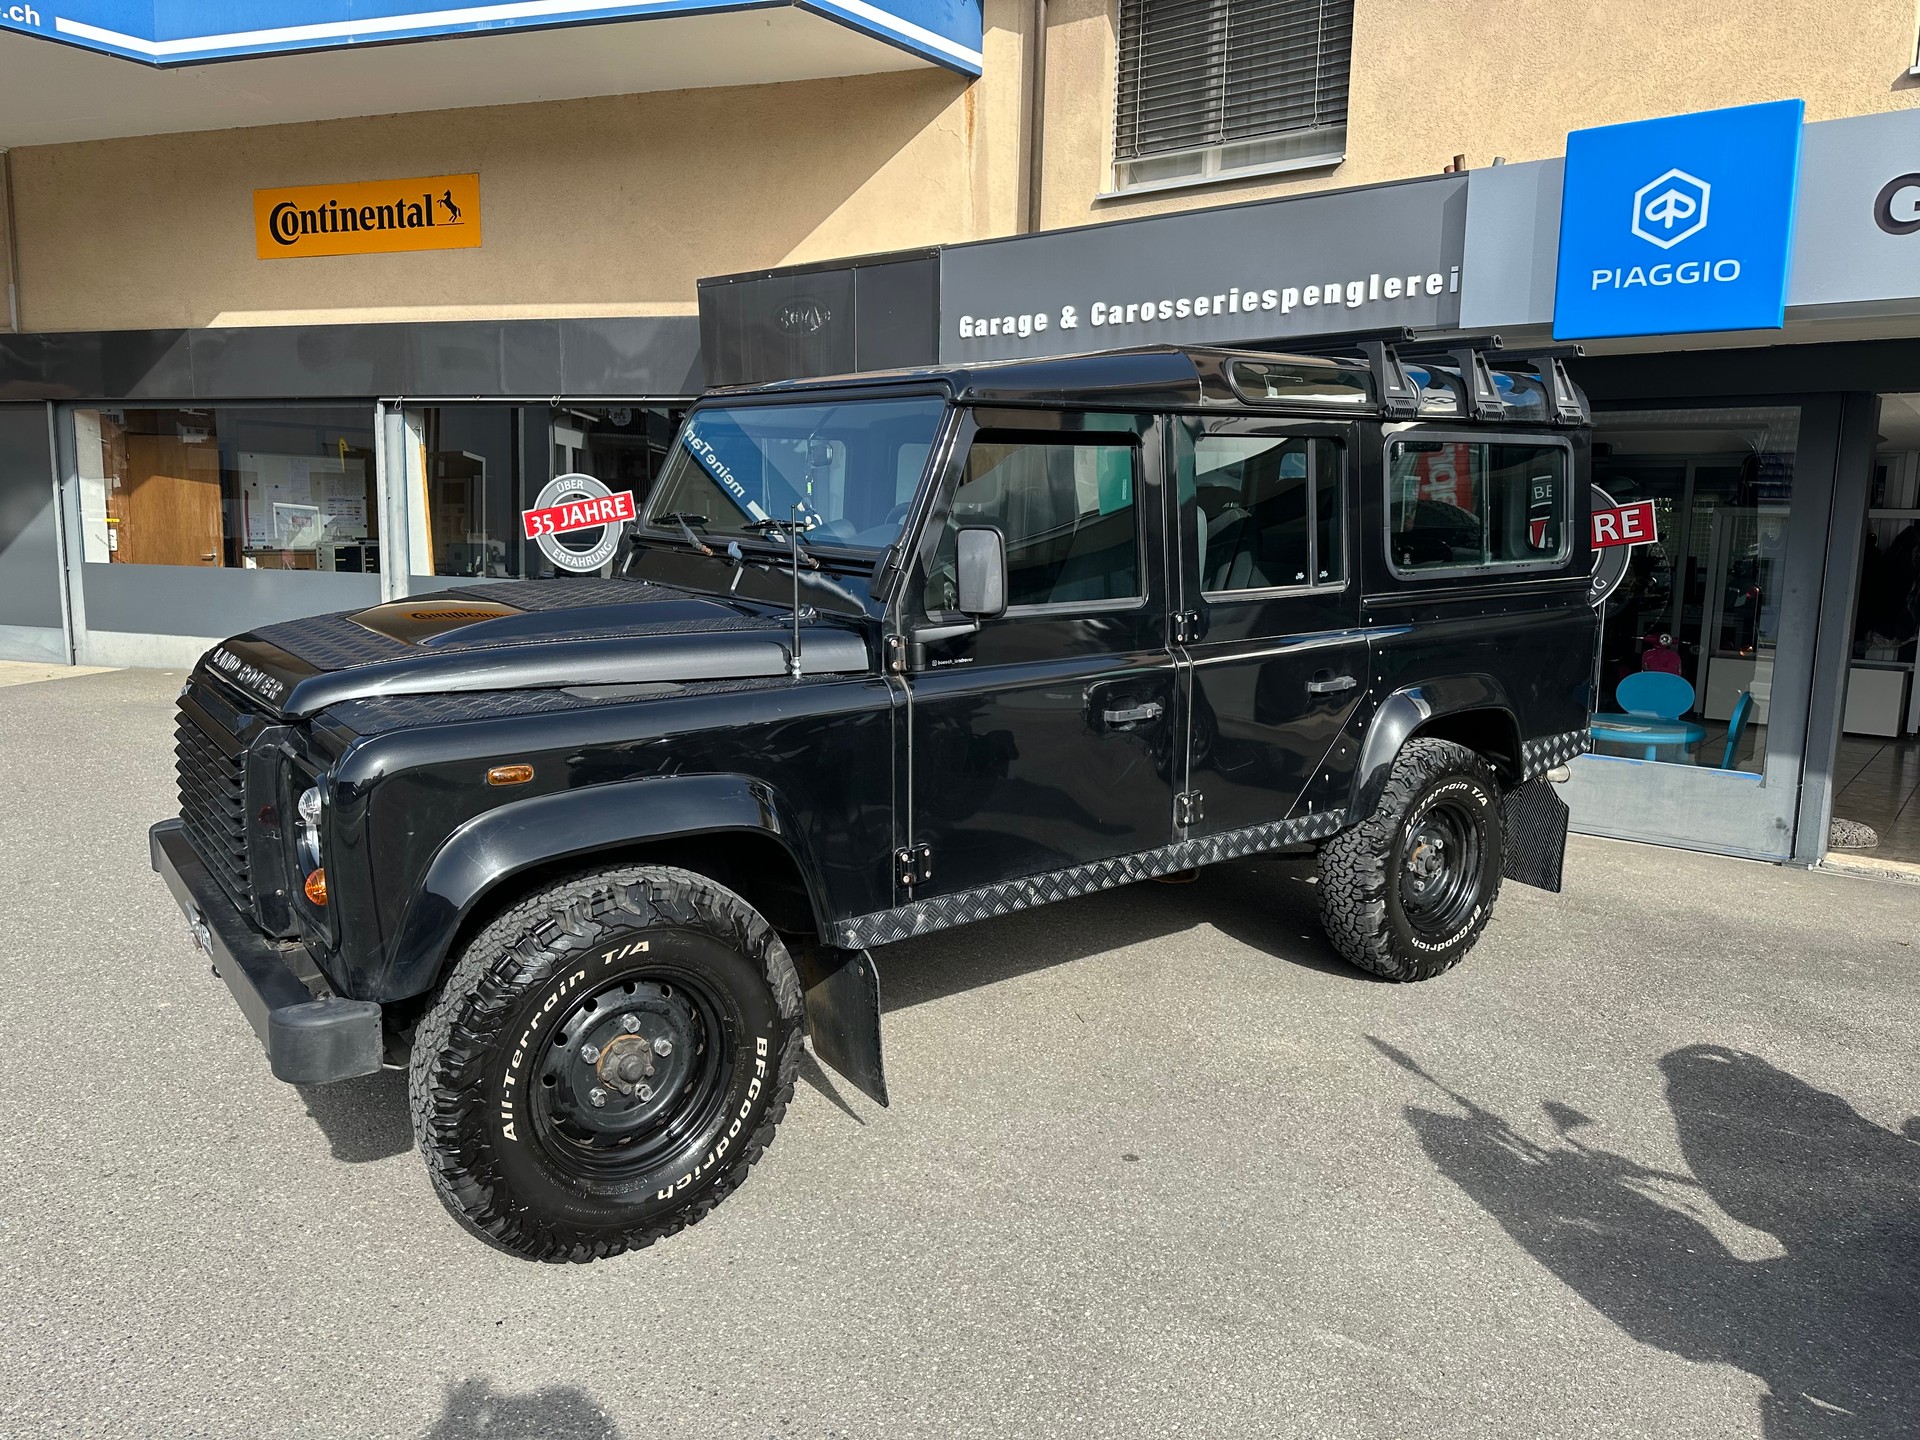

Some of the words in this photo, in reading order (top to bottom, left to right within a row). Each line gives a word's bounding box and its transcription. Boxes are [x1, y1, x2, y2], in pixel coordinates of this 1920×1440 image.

[0, 4, 41, 27] .ch
[269, 194, 435, 246] Continental
[1873, 172, 1920, 235] G
[1591, 259, 1741, 291] PIAGGIO
[959, 312, 1049, 339] Garage
[1059, 305, 1079, 329] &
[1090, 265, 1460, 327] Carosseriespenglerei
[556, 479, 584, 493] ÜBER
[531, 514, 555, 537] 35
[560, 496, 629, 528] JAHRE
[1594, 508, 1644, 543] RE
[552, 541, 613, 567] ERFAHRUNG
[212, 647, 241, 672] LAND
[237, 664, 284, 700] ROVER
[1405, 781, 1469, 838] All-Terrain
[1471, 786, 1488, 807] T/A
[1411, 904, 1482, 952] BFGoodrich
[501, 968, 586, 1142] All-Terrain
[601, 940, 650, 965] T/A
[657, 1036, 768, 1201] BFGoodrich
